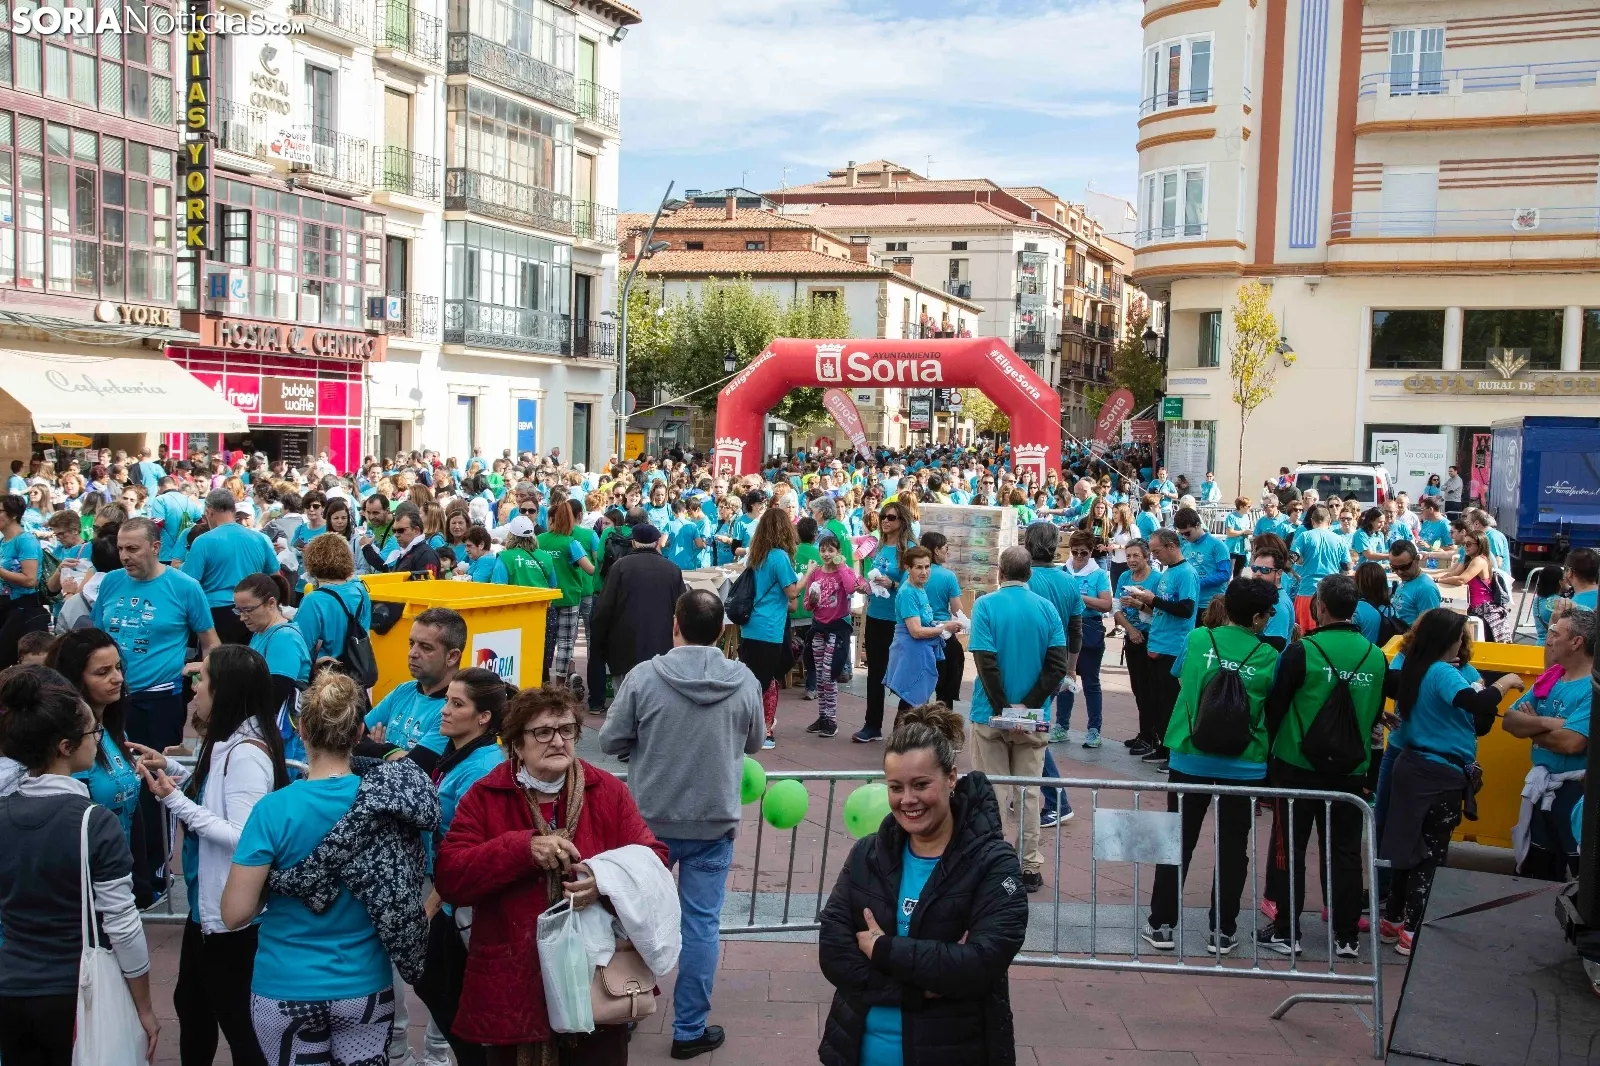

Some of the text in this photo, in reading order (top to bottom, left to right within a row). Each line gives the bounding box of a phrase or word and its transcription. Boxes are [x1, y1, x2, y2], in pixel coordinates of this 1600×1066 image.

[250, 70, 290, 97] HOSTAL
[250, 91, 291, 116] CENTRO
[283, 138, 311, 152] Quiere
[284, 148, 311, 162] Futuro
[187, 142, 205, 247] YORK
[213, 320, 283, 352] HOSTAL
[312, 331, 377, 360] CENTRO
[872, 351, 942, 360] AYUNTAMIENTO
[847, 352, 943, 382] Soria
[989, 348, 1041, 401] #EligeSoria
[281, 382, 315, 398] bubble
[1403, 375, 1470, 393] CAJA
[1477, 381, 1515, 391] RURAL
[1519, 381, 1536, 391] DE
[284, 398, 315, 411] waffle
[1099, 397, 1126, 431] Soria
[518, 421, 533, 430] BBVA
[1415, 451, 1444, 460] contigo
[1220, 659, 1257, 676] aecc
[1339, 670, 1374, 683] aecc
